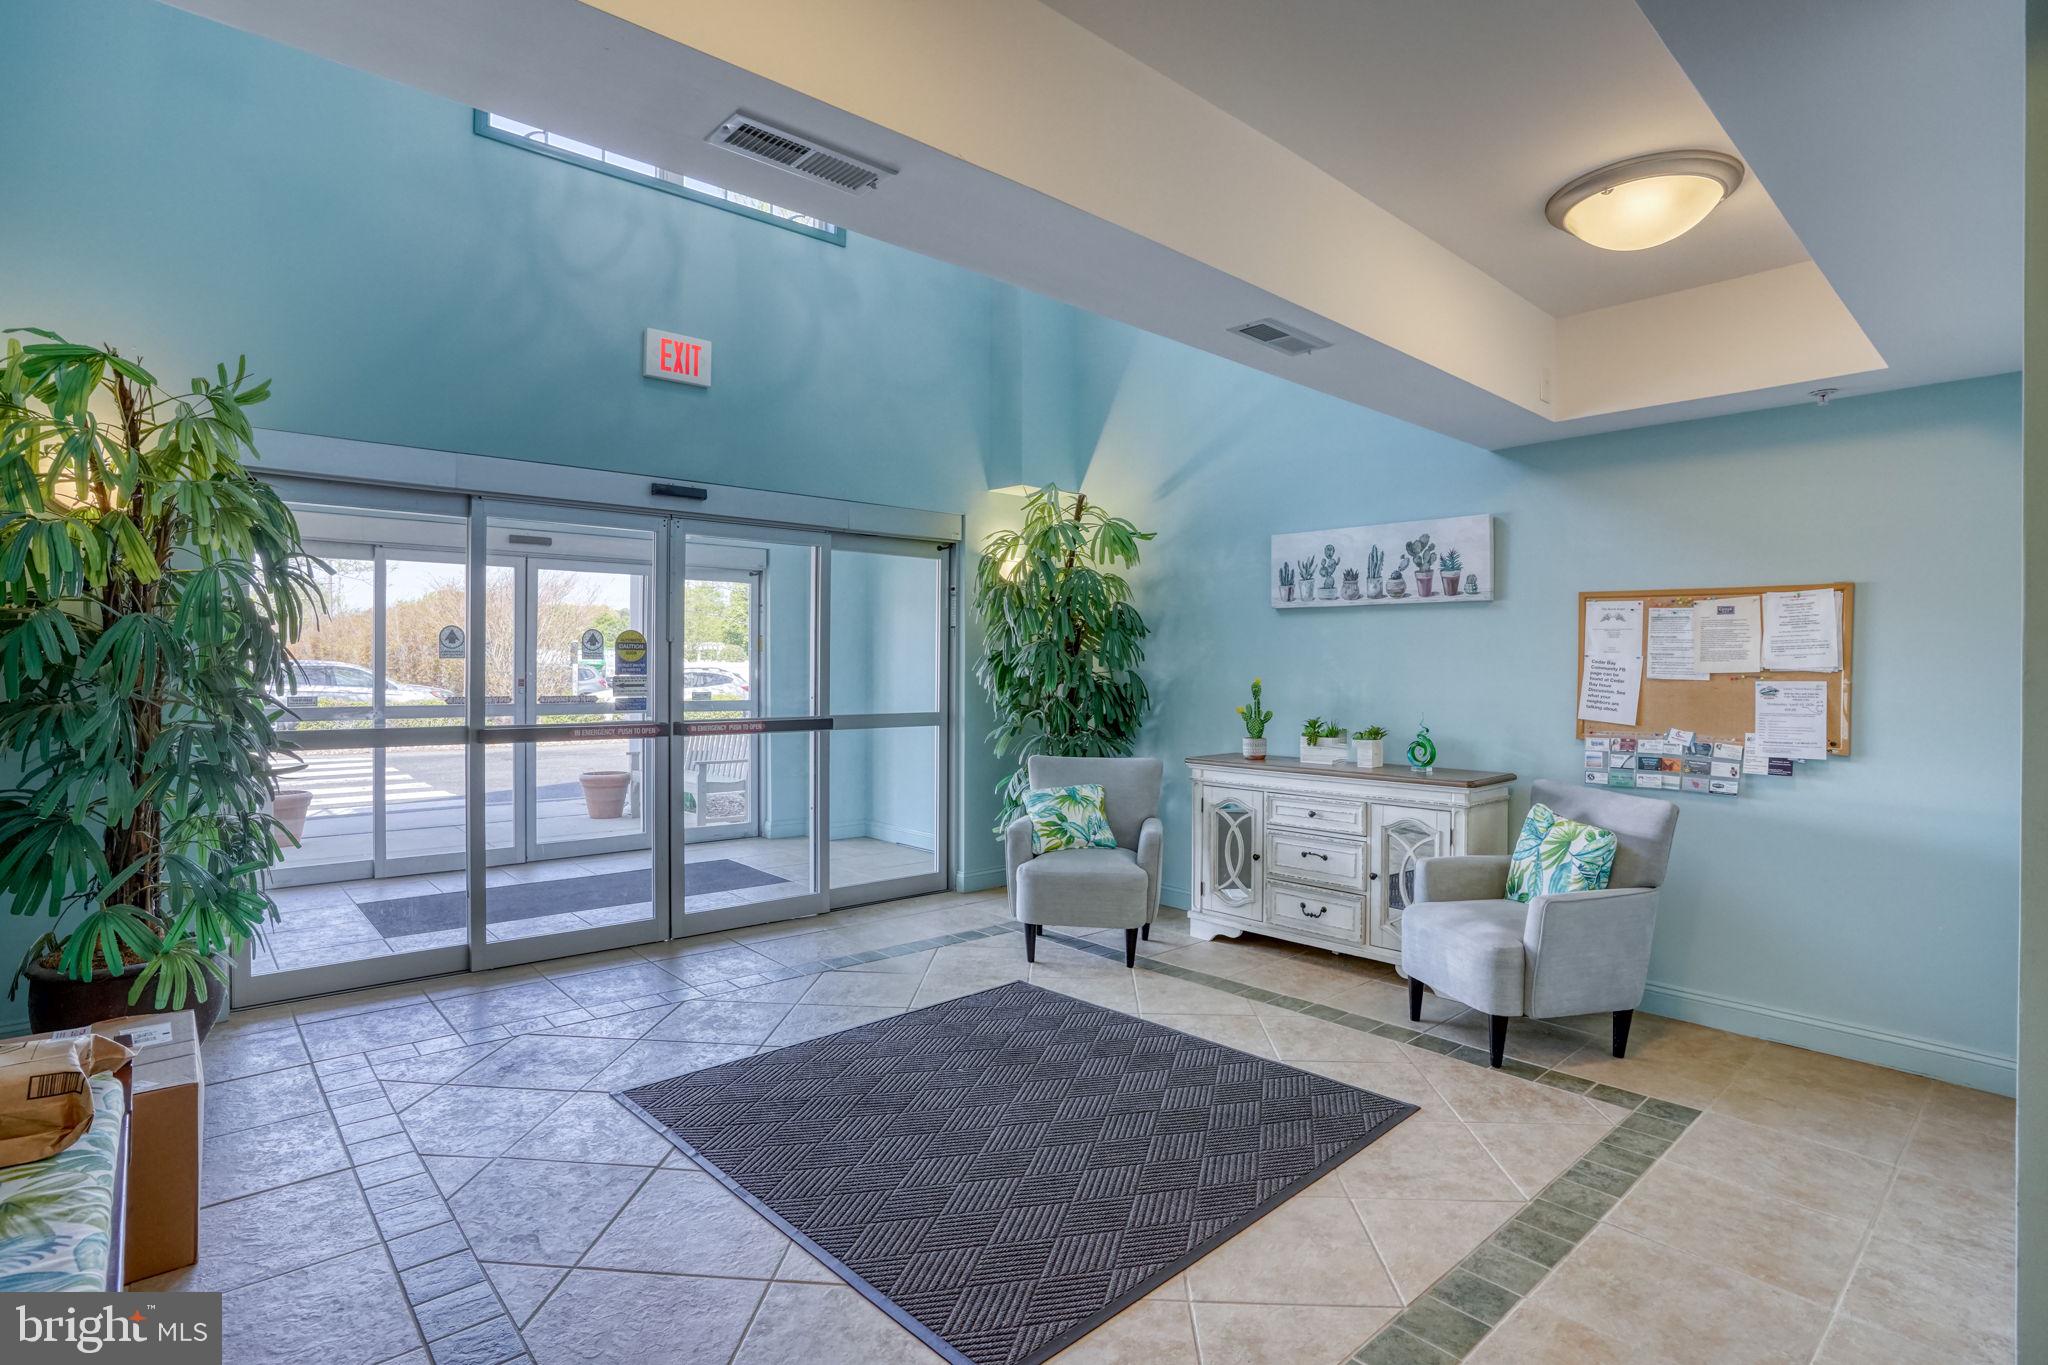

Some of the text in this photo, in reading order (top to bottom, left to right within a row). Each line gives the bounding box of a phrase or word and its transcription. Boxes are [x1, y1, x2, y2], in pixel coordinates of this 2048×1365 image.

[660, 338, 702, 377] EXIT
[582, 728, 616, 736] EMERGENCY
[618, 727, 632, 735] PUSH
